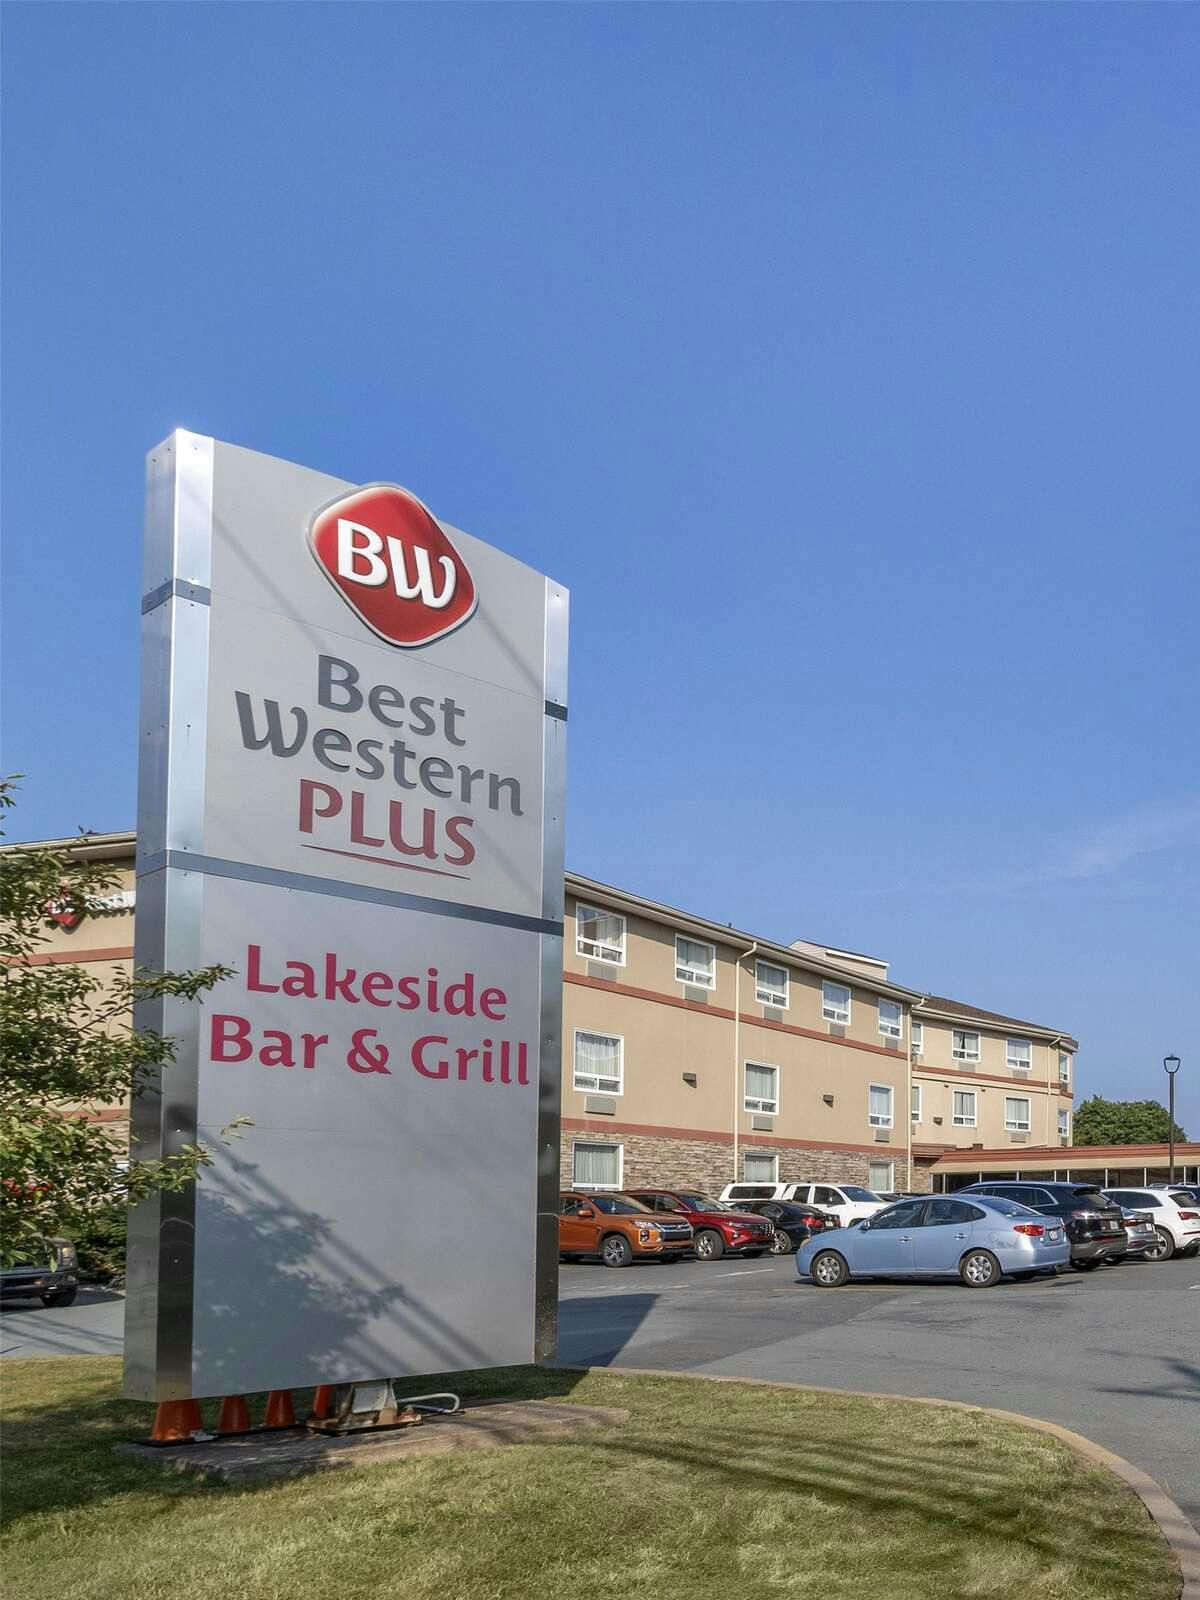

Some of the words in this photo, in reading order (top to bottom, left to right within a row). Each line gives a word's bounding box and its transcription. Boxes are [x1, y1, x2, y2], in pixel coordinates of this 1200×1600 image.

[336, 518, 456, 609] BW
[318, 654, 466, 747] Best
[234, 690, 524, 817] Western
[299, 779, 476, 866] PLUS
[247, 944, 508, 1021] Lakeside
[210, 1014, 329, 1069] Bar
[346, 1028, 392, 1075] &
[411, 1035, 530, 1086] Grill
